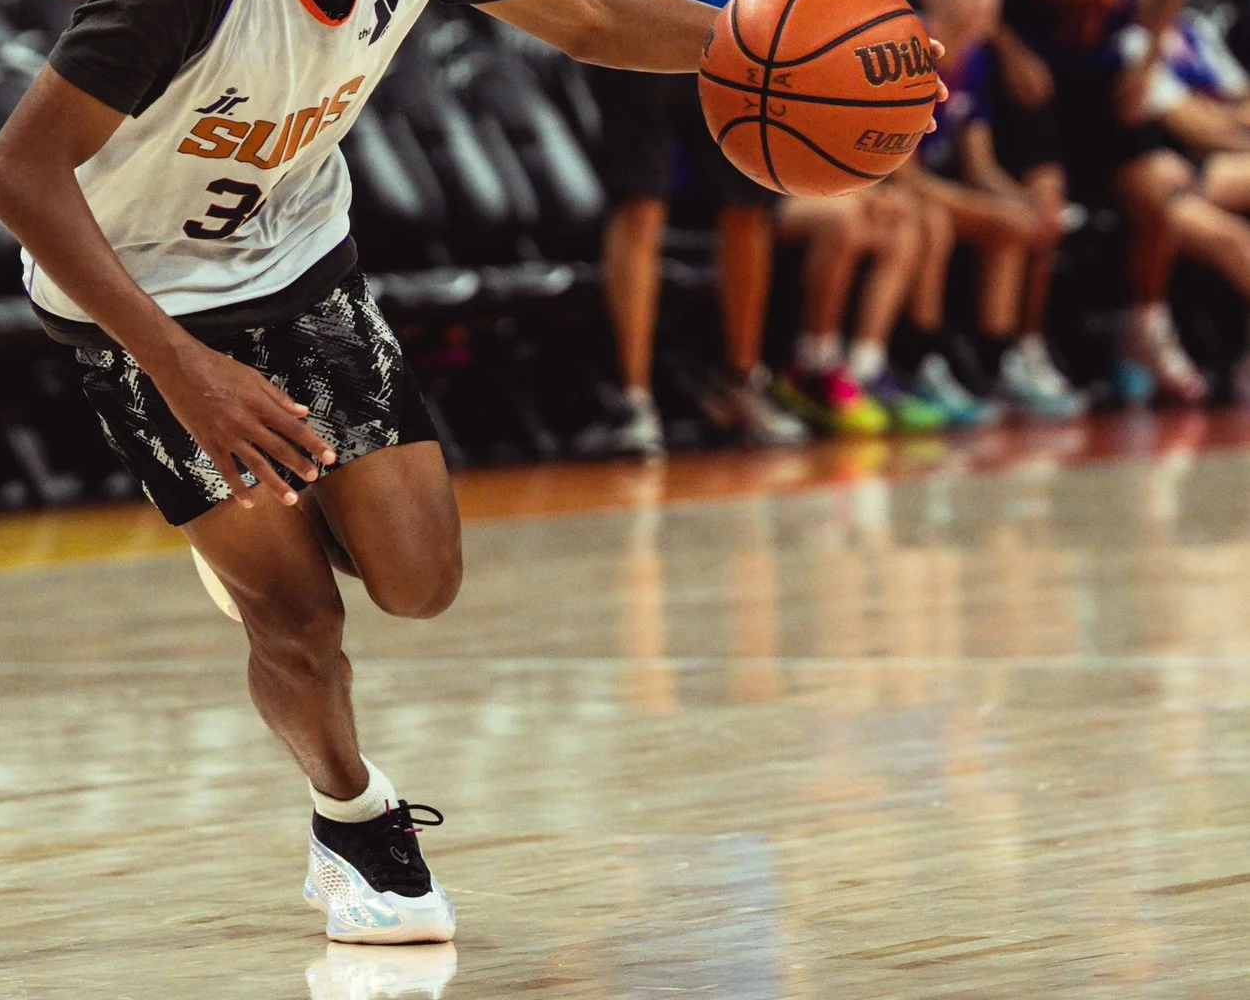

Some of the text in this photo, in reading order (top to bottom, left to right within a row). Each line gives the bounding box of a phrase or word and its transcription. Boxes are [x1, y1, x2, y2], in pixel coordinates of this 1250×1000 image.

[854, 35, 937, 87] Wils
[856, 129, 925, 151] EVOLU
[183, 178, 280, 239] 3
